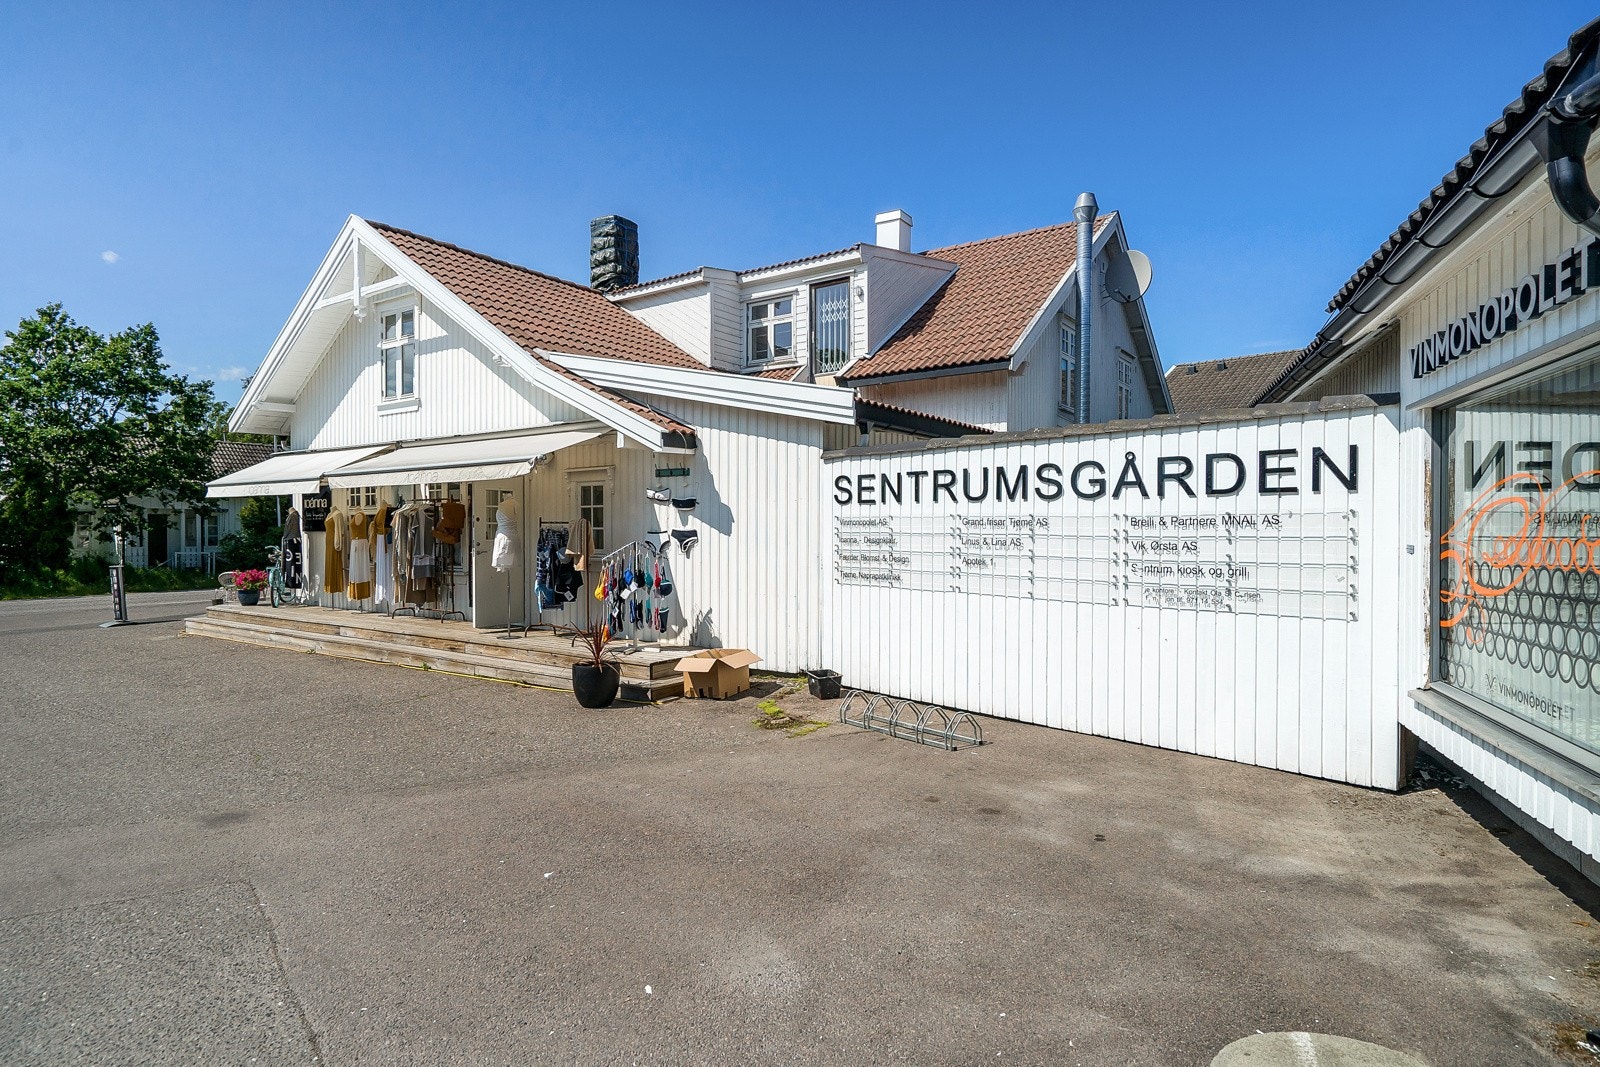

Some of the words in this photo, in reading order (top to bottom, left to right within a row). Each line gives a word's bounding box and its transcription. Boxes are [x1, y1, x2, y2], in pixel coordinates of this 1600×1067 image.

[1409, 234, 1598, 379] VINMONOPOLET
[834, 444, 1358, 506] SENTRUMSGÅRDEN
[840, 518, 876, 527] Vinmonopolet
[962, 517, 984, 526] Grand
[1009, 517, 1033, 528] Tjøme
[1036, 517, 1048, 527] AS
[1159, 516, 1167, 526] &
[1171, 516, 1217, 526] Partnere
[1222, 515, 1257, 525] MNAL
[1262, 514, 1280, 525] AS
[961, 537, 980, 546] Linus
[983, 537, 989, 546] &
[991, 537, 1007, 546] Lina
[1010, 537, 1022, 546] AS
[1131, 541, 1146, 550] Vik
[1150, 541, 1178, 551] Ørsta
[1182, 541, 1198, 551] AS
[889, 555, 910, 564] Design
[962, 556, 986, 566] Apotek
[1177, 564, 1204, 575] kiosk
[1209, 567, 1222, 578] og
[1227, 566, 1247, 578] grill
[1499, 682, 1563, 720] VINMONOPOLET
